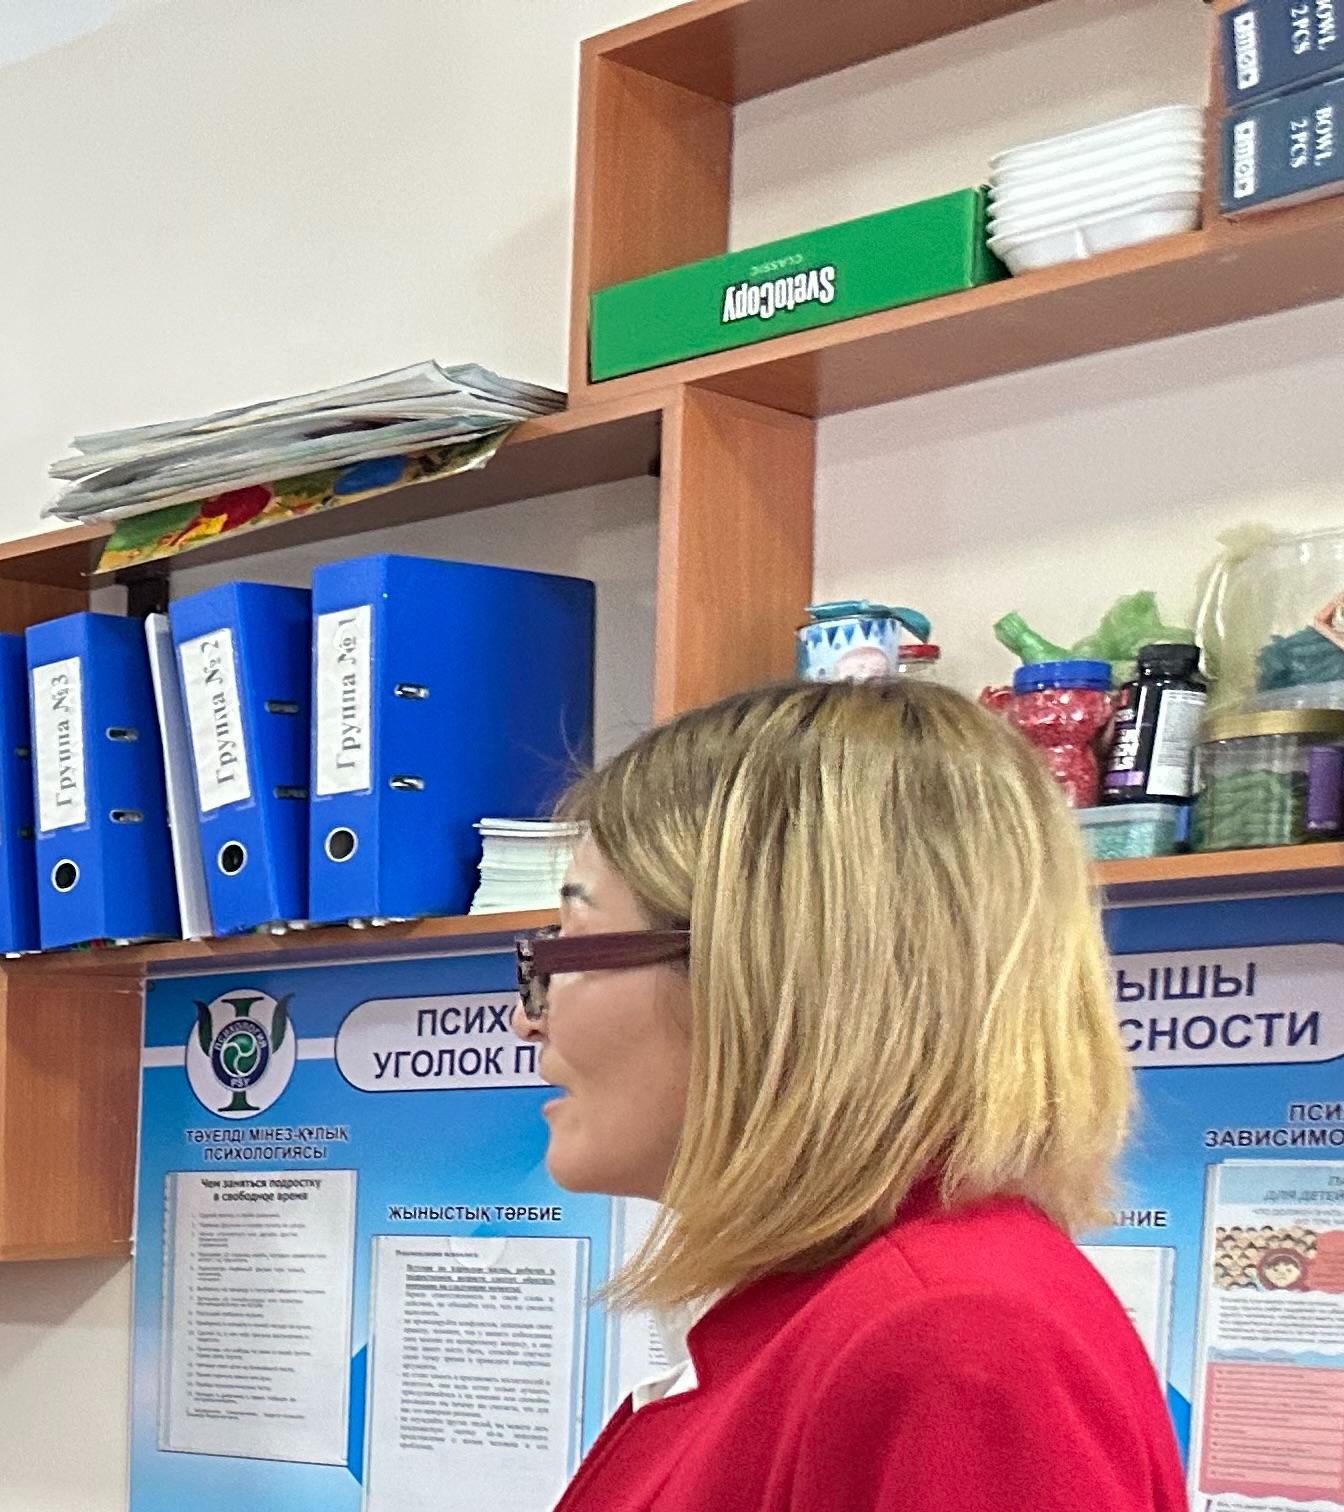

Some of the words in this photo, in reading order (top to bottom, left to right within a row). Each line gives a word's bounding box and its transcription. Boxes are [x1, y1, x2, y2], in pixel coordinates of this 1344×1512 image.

[750, 254, 804, 277] CLASSIC
[722, 265, 835, 323] SvetoCopy
[212, 691, 238, 785] Группа
[336, 673, 361, 770] Группа
[55, 719, 77, 807] Группа
[417, 1004, 516, 1037] ПСИХ
[373, 1046, 505, 1079] УГОЛОК
[1289, 1103, 1344, 1121] ПСИ
[186, 1128, 245, 1144] ТӘУЕЛДІ
[204, 1146, 328, 1161] ПСИХОЛОГИЯСЫ
[388, 1205, 492, 1222] ЖЫНЫСТЫҚ
[495, 1206, 563, 1221] ТӘРБИЕ
